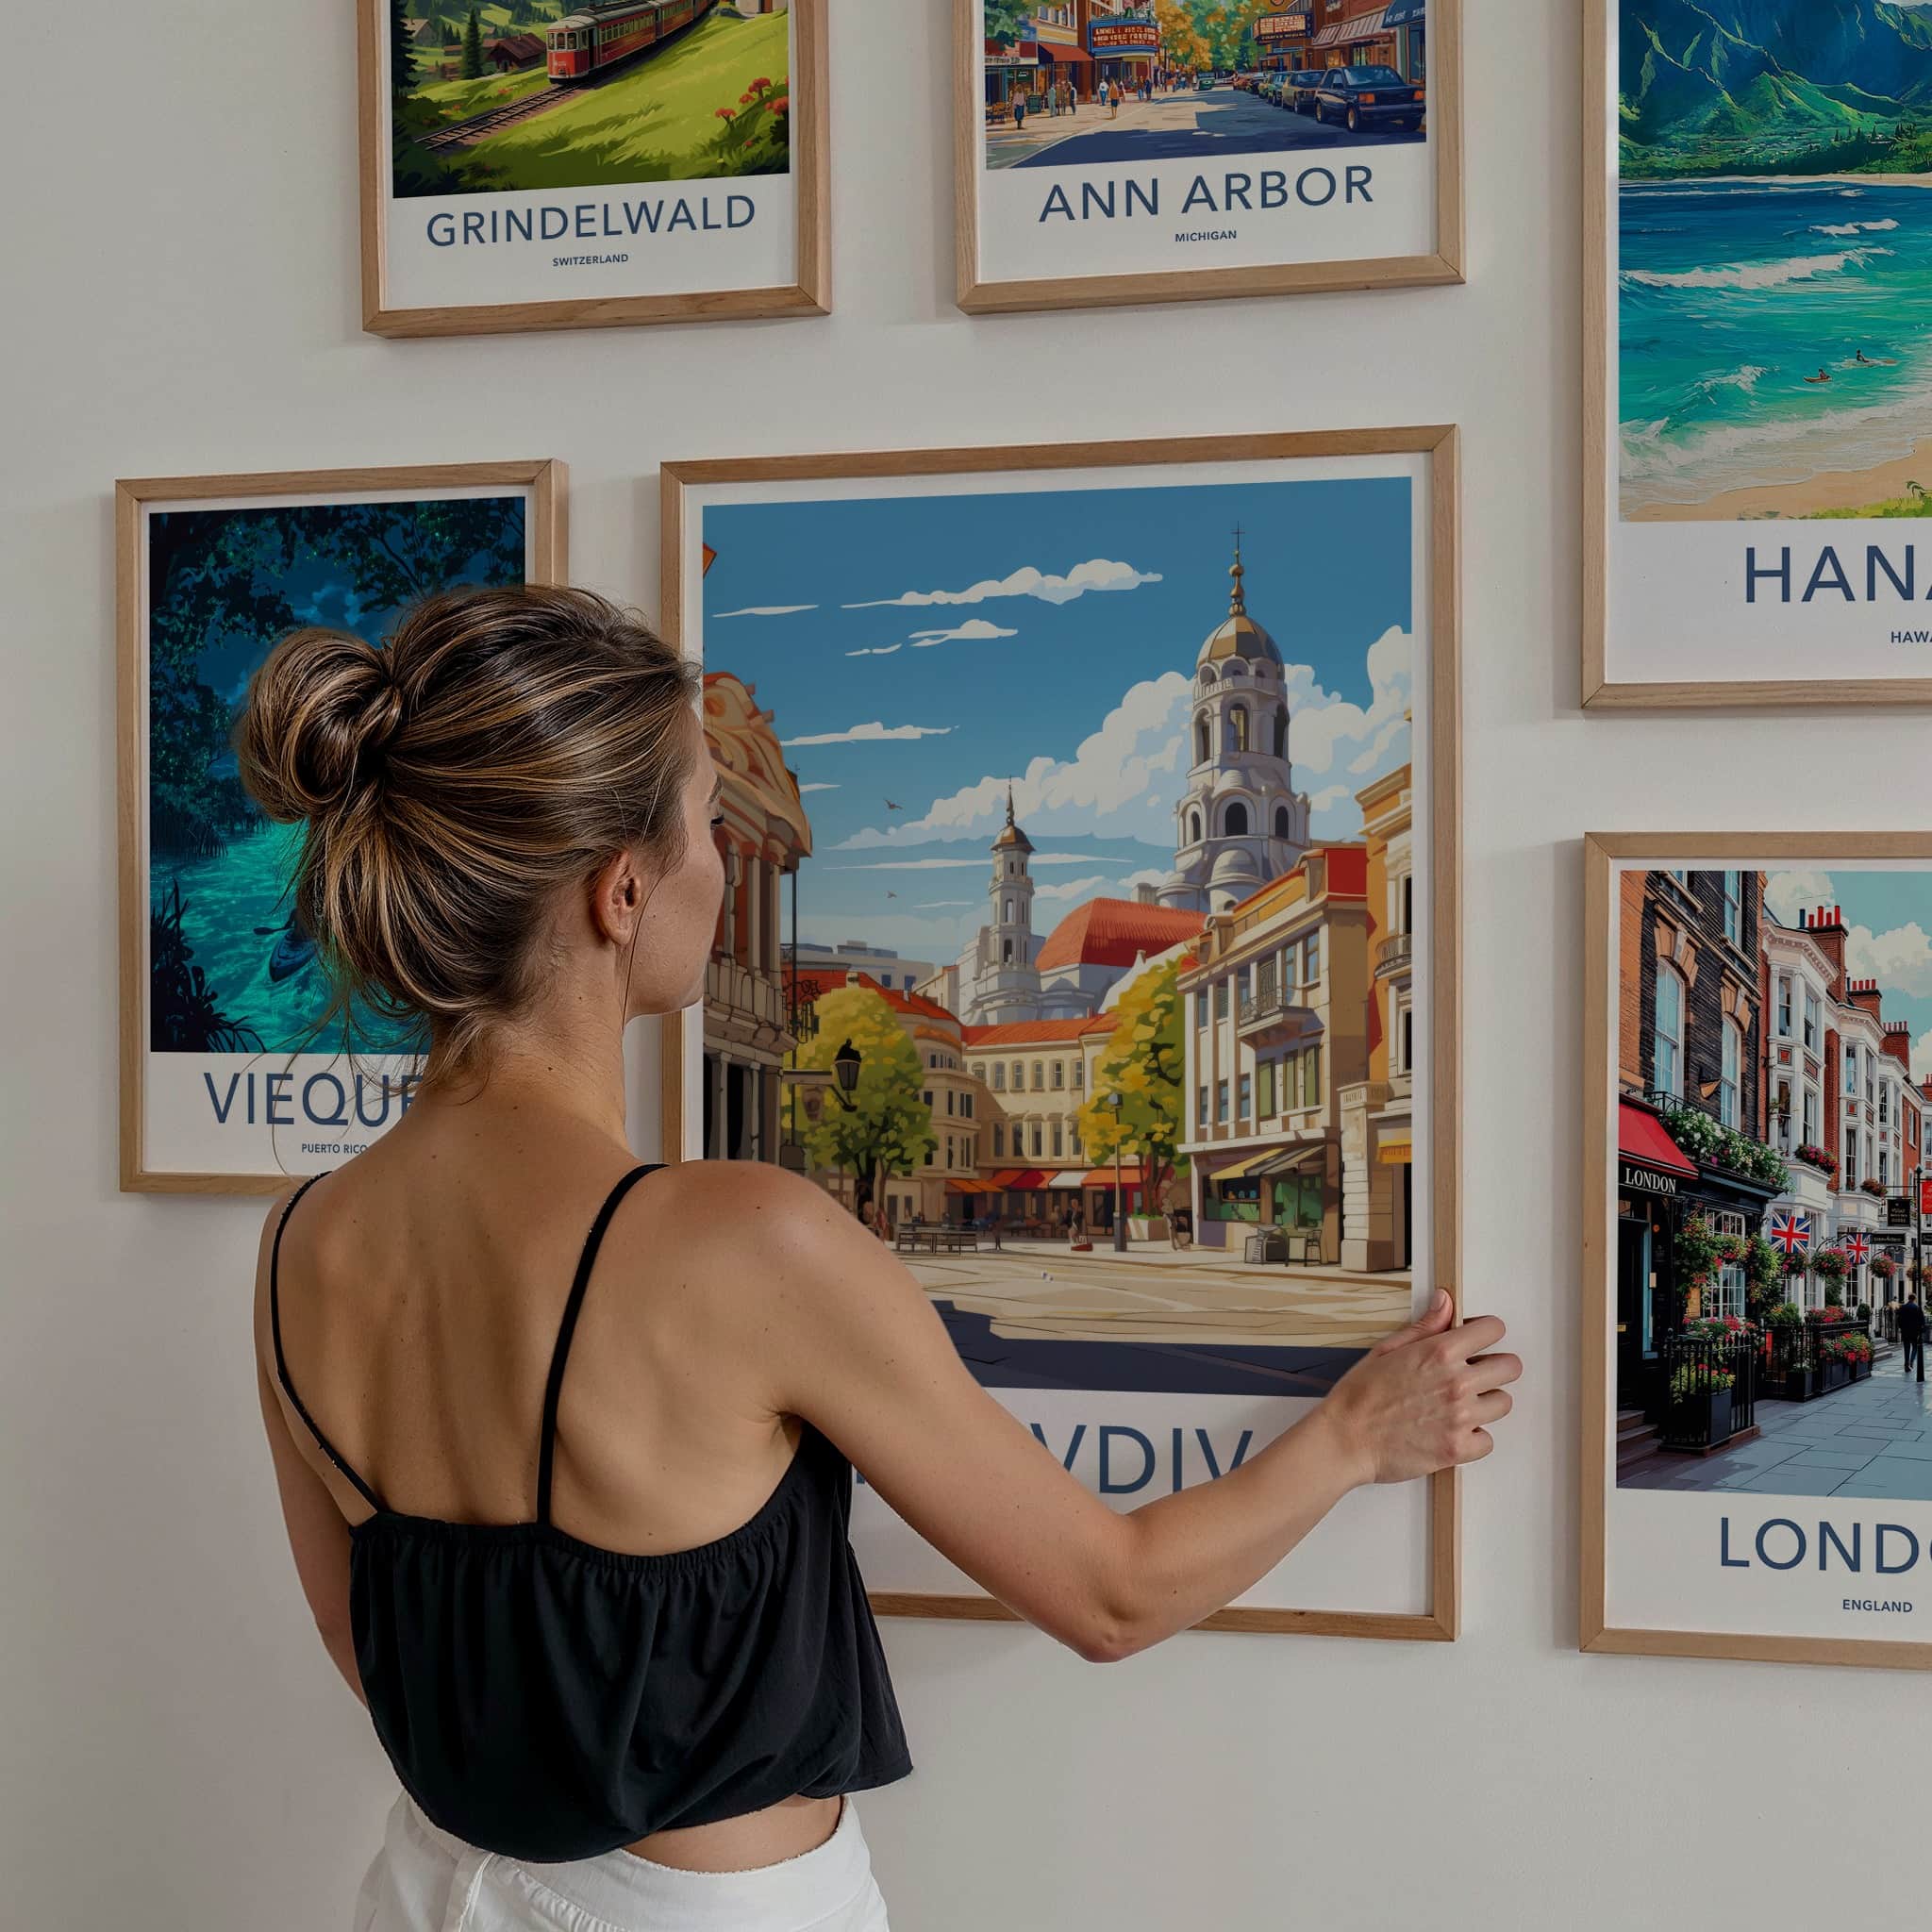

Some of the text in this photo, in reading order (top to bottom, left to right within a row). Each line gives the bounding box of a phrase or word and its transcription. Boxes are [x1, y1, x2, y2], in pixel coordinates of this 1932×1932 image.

[1039, 165, 1374, 223] ANN ARBOR
[426, 194, 756, 247] GRINDELWALD
[1174, 229, 1238, 242] MICHIGAN
[552, 253, 629, 267] SWITZERLAND
[1746, 544, 1932, 603] HAN
[1890, 630, 1932, 643] HAW
[301, 1143, 341, 1154] PUERTO
[1624, 1167, 1676, 1194] LONDON
[1720, 1516, 1932, 1574] LOND
[1842, 1598, 1913, 1613] ENGLAND
